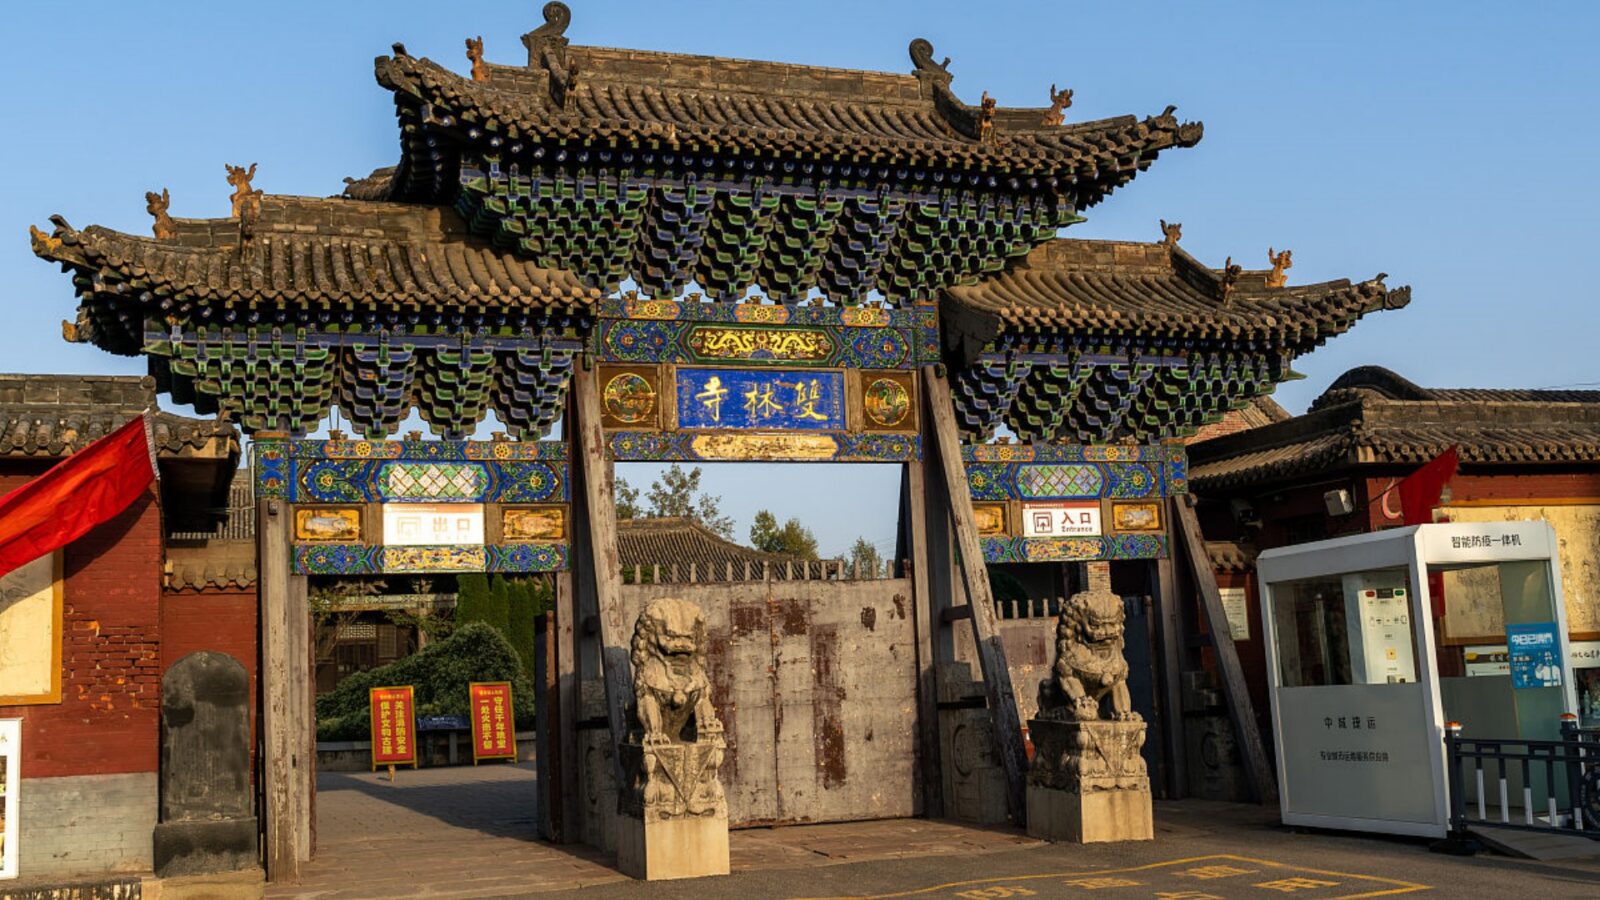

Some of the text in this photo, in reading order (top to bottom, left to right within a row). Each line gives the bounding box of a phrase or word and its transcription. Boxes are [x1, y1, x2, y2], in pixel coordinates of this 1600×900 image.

[432, 516, 470, 532] 出口
[1061, 511, 1091, 524] 入口
[1061, 525, 1093, 533] Entrance
[1451, 533, 1522, 549] 智能防疫一体机
